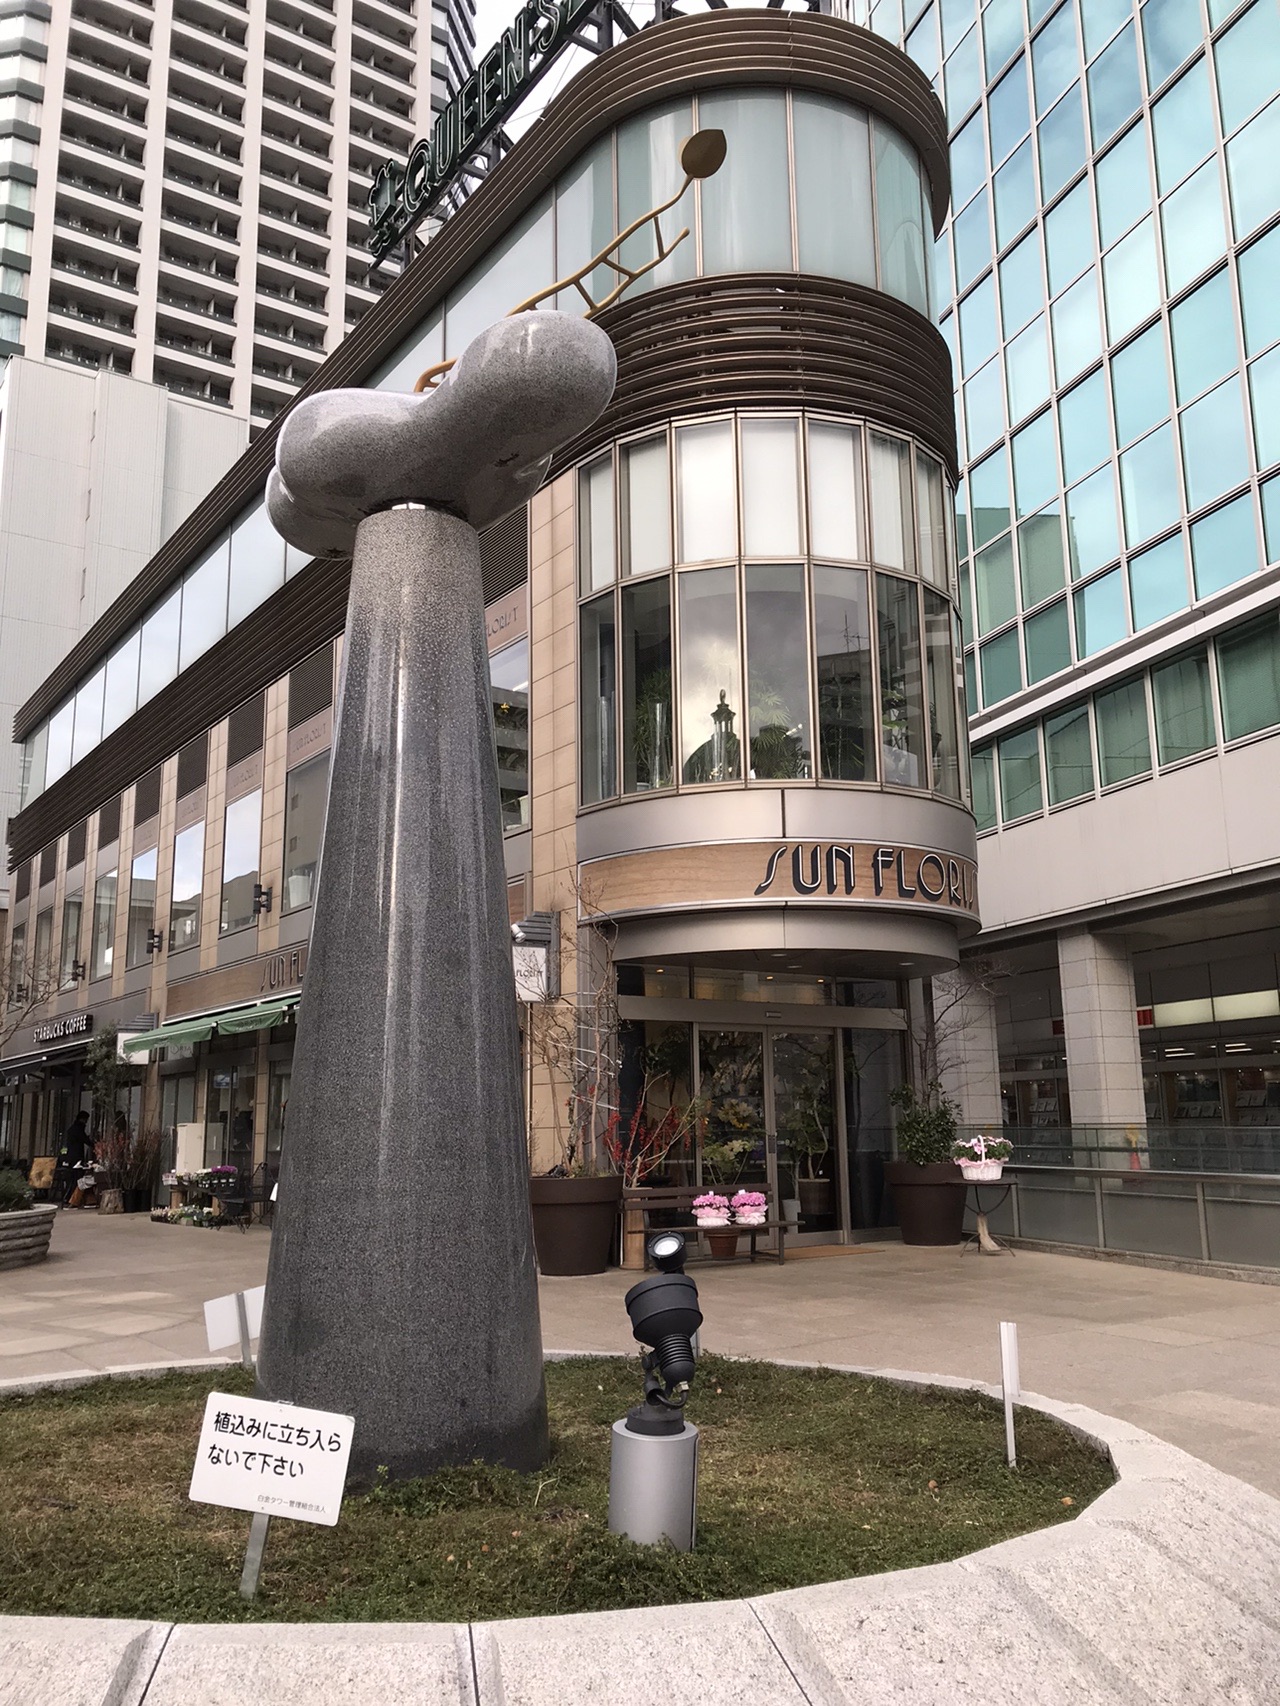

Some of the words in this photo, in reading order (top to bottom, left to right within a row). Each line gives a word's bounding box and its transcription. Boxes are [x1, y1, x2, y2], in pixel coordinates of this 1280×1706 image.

[755, 844, 855, 896] SUN
[33, 1021, 64, 1043] STARBUCKS
[65, 1014, 88, 1035] COFFEE
[213, 1411, 342, 1452] 植込みに立ち入ら
[208, 1443, 304, 1478] ないで下さい
